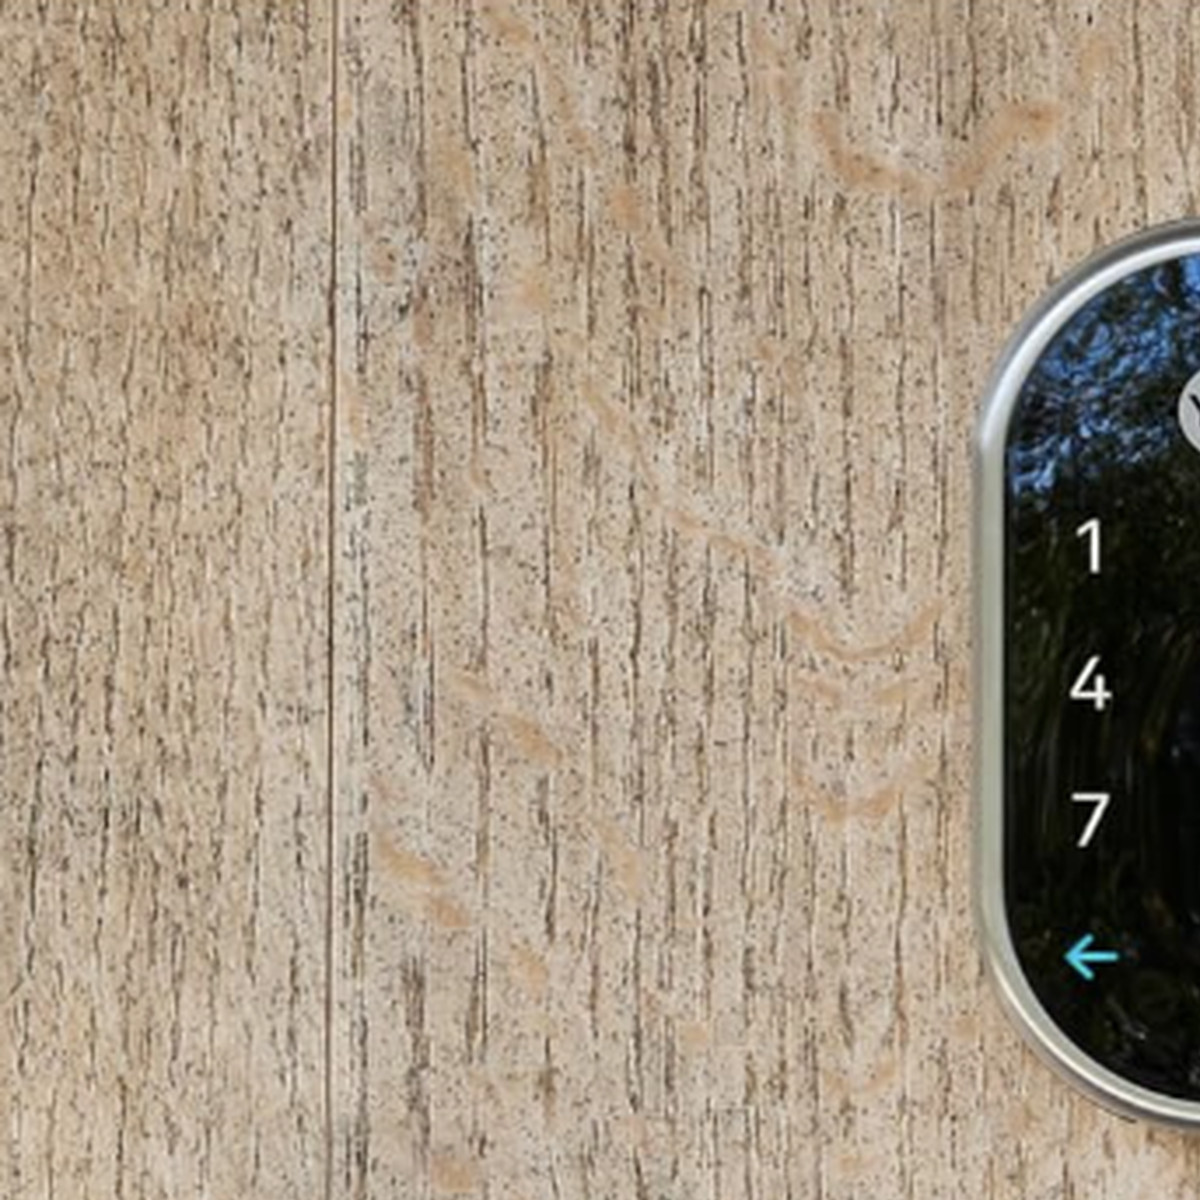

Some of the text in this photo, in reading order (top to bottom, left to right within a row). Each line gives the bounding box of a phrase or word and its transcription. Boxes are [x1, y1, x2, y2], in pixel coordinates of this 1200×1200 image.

[1076, 518, 1100, 573] 1
[1070, 656, 1112, 710] 4
[1072, 792, 1110, 847] 7
